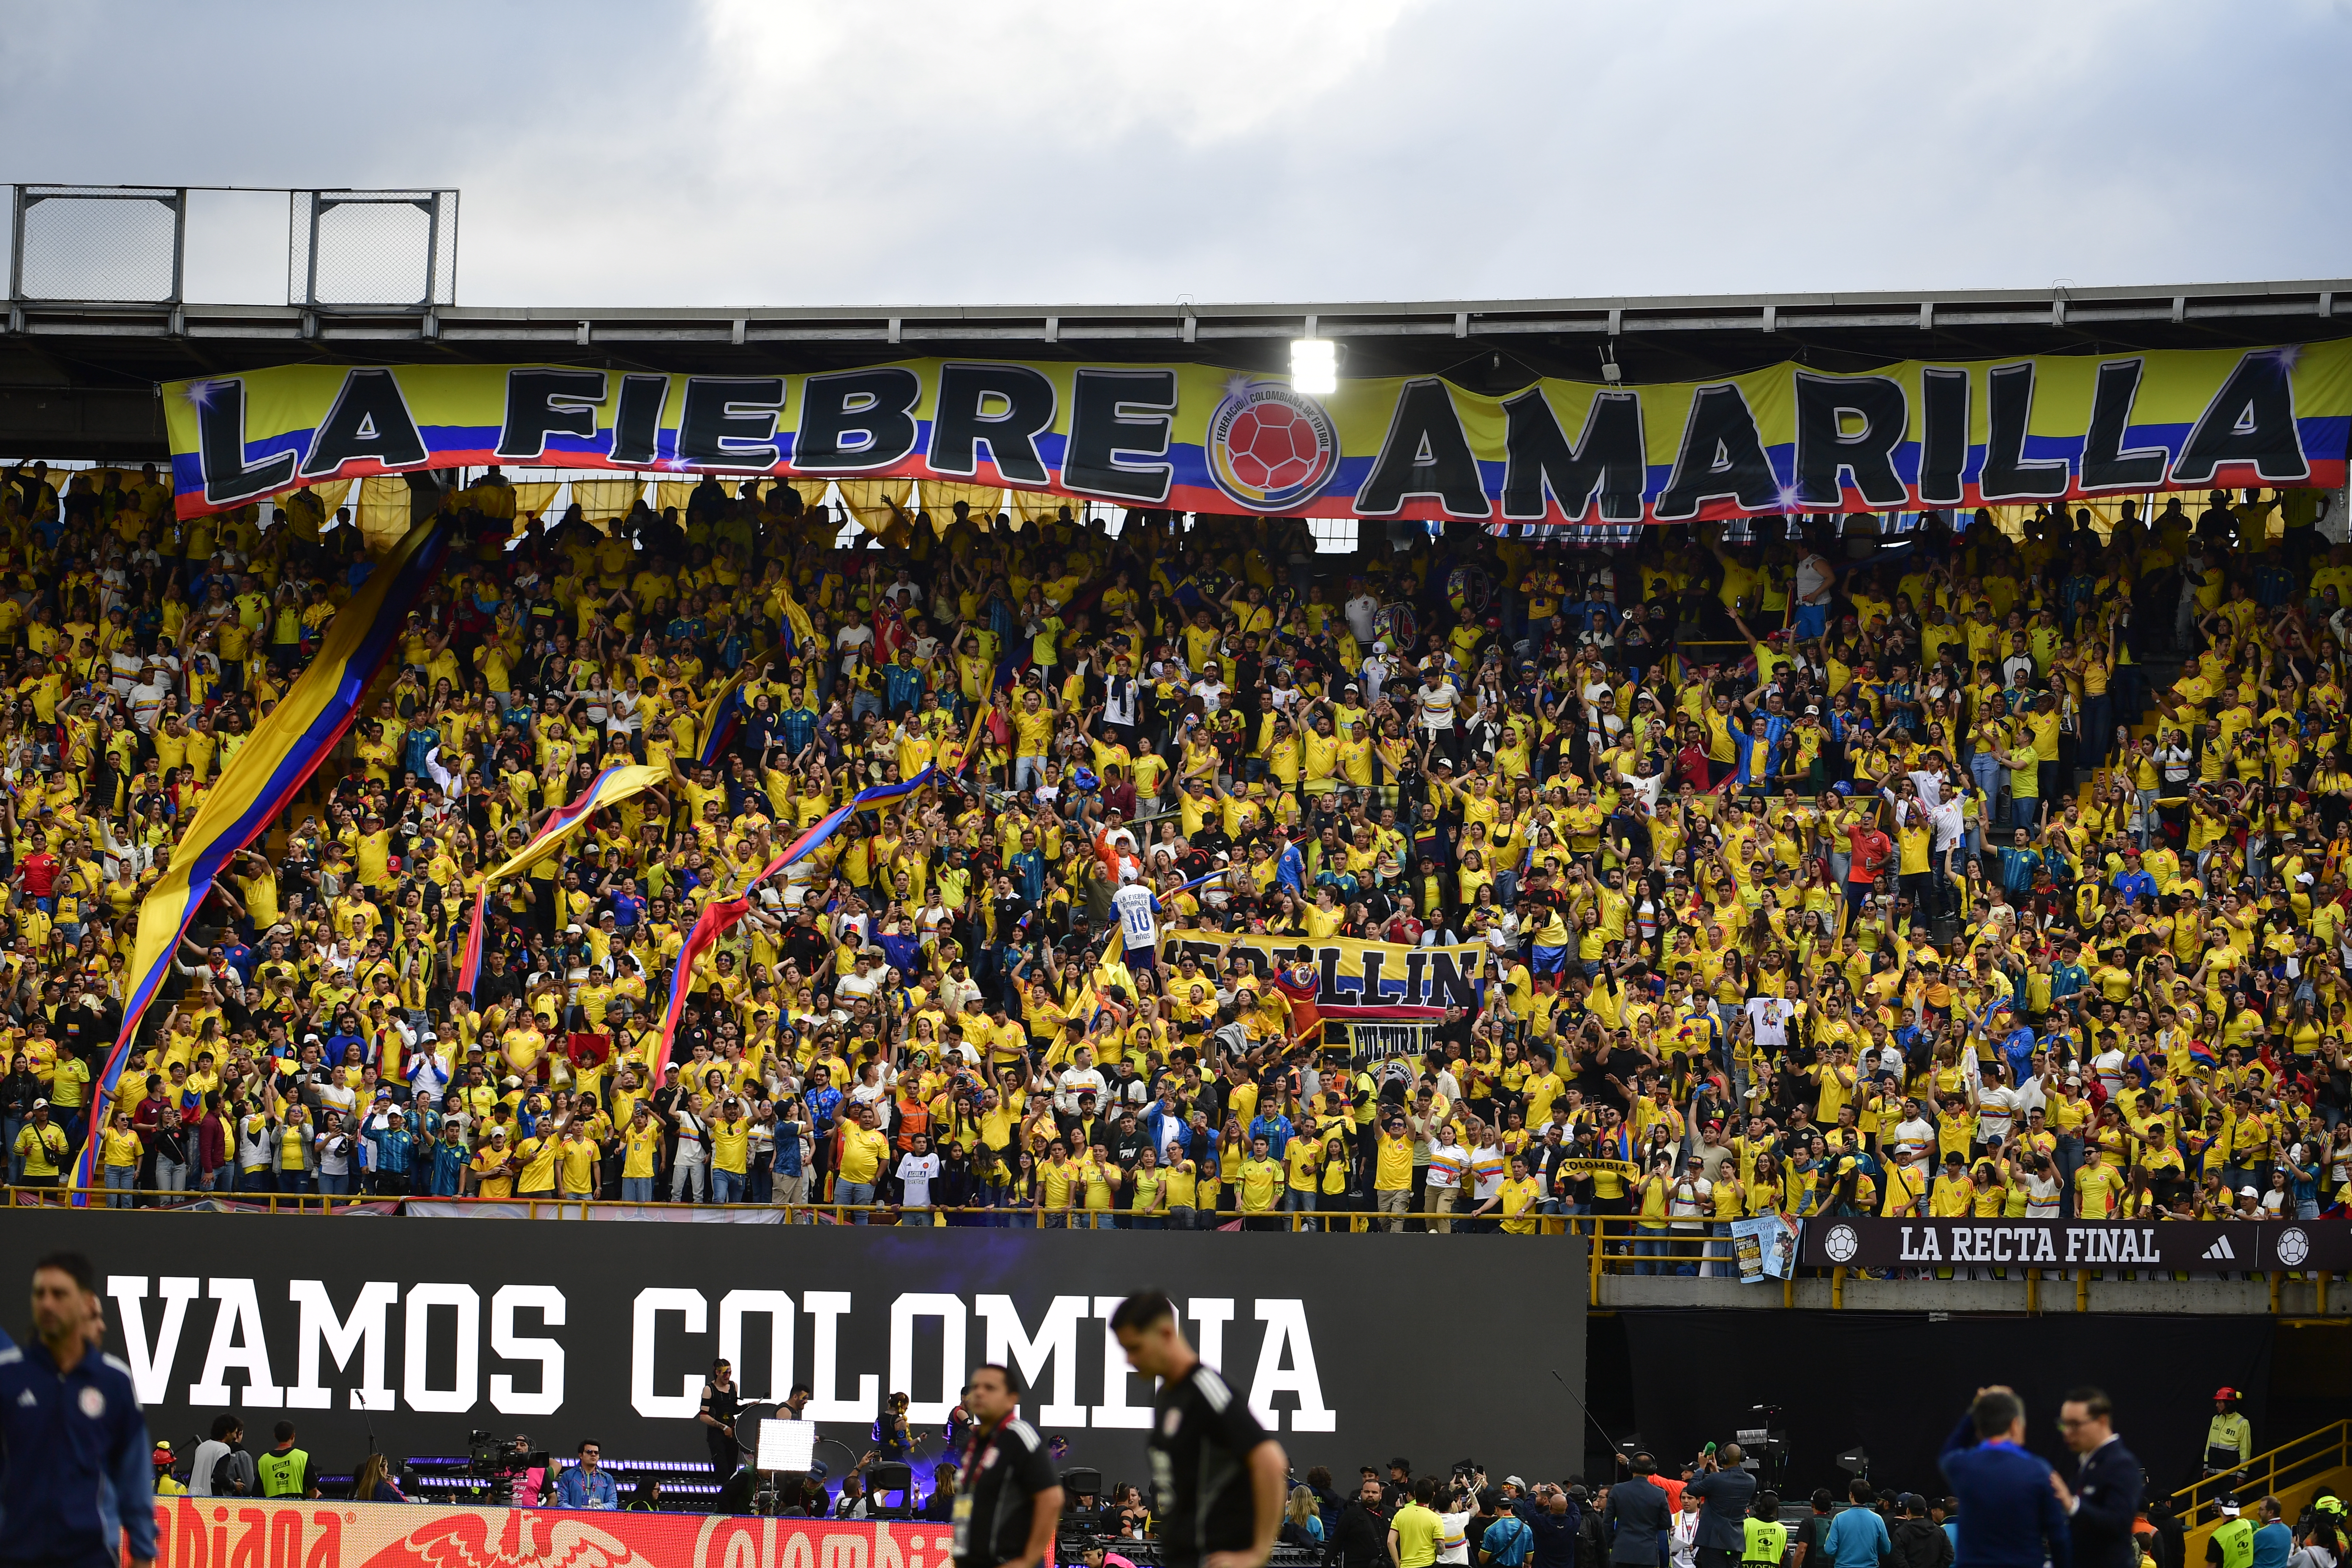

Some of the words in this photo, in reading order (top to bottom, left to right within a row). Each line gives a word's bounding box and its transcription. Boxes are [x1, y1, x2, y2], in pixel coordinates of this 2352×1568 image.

[1250, 390, 1303, 410] COLOMBIANA
[1302, 406, 1314, 418] DE
[196, 366, 429, 506] LA
[493, 360, 1177, 503] FIEBRE
[1352, 347, 2311, 522] AMARILLA
[1206, 584, 1214, 593] 18
[1805, 736, 1812, 745] 10
[1122, 899, 1148, 909] AMARILLA
[1126, 907, 1150, 934] 10
[1135, 933, 1150, 941] AÑOS
[1353, 1026, 1419, 1064] CULTURA
[1391, 1064, 1413, 1085] AMARILL
[634, 1143, 640, 1151] 10
[1563, 1160, 1628, 1174] COLOMBIA
[1900, 1227, 1942, 1261] LA
[1951, 1227, 2057, 1261] RECTA
[2065, 1228, 2160, 1263] FINAL
[107, 1275, 566, 1415] VAMOS
[2225, 1428, 2236, 1437] 911
[274, 1462, 289, 1470] AGUILA
